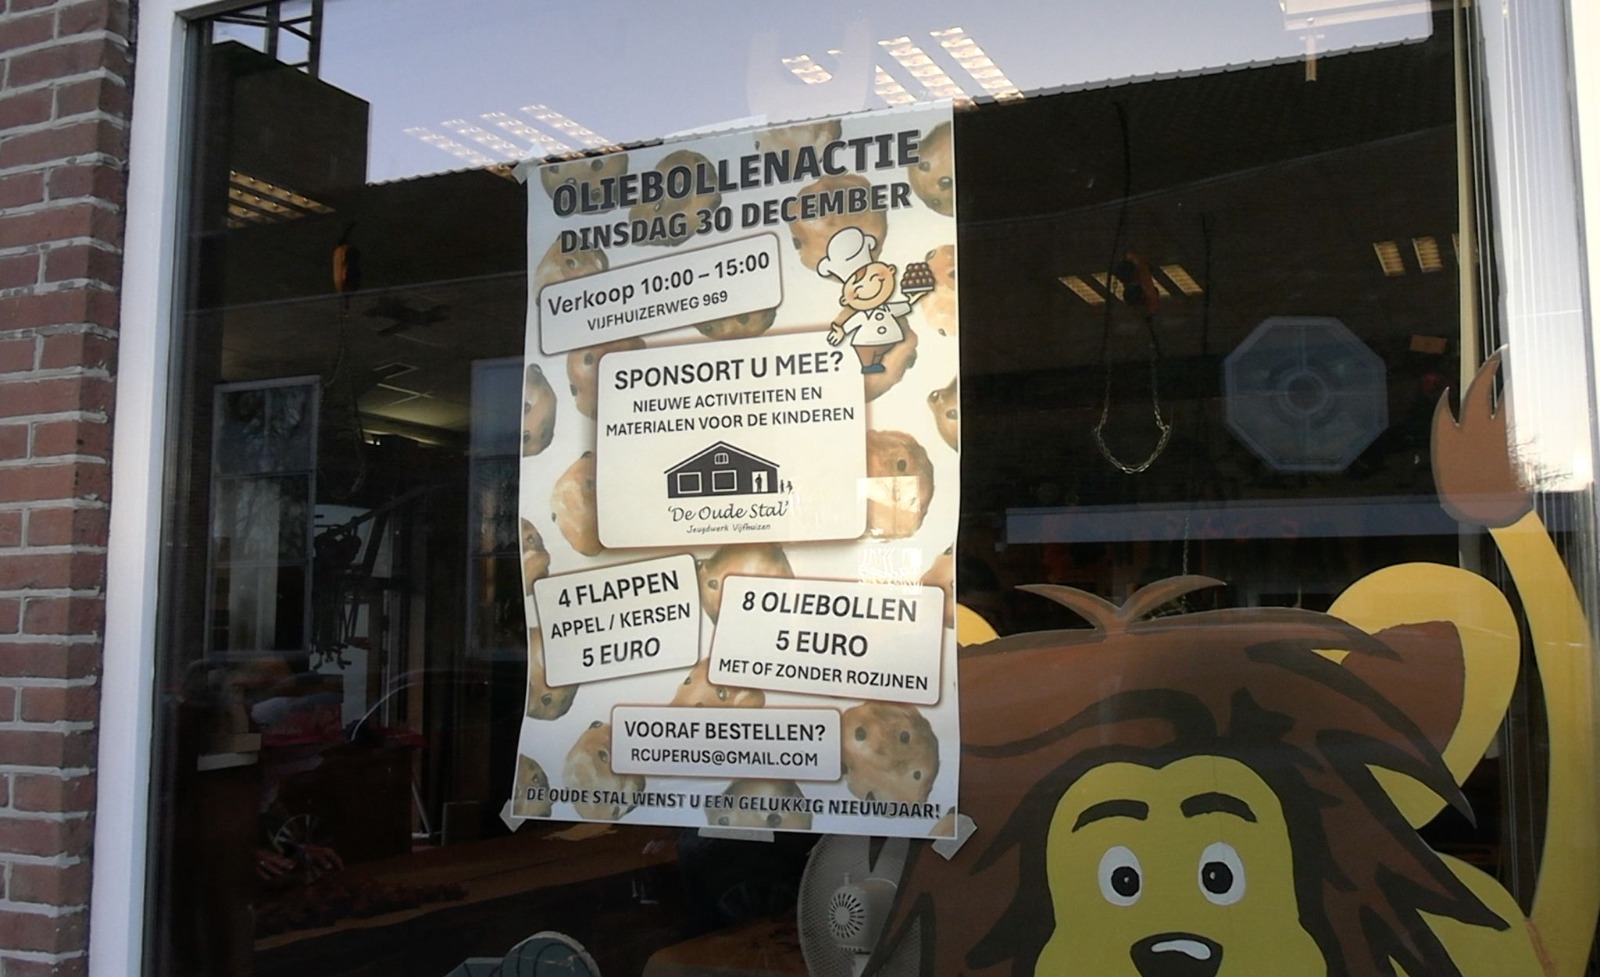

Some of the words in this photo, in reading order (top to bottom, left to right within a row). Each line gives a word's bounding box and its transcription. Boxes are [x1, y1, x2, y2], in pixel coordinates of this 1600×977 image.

[552, 129, 921, 217] OLIEBOLLENACTIE
[560, 213, 688, 255] DINSDAG
[696, 202, 731, 236] 30
[740, 182, 912, 228] DECEMBER
[548, 282, 634, 316] Verkoop
[641, 269, 694, 296] 10:00
[714, 251, 770, 279] 15:00
[587, 296, 699, 331] VIJFHUIZERWEG
[702, 291, 728, 307] 969
[614, 359, 745, 390] SPONSORT
[750, 358, 768, 378] U
[776, 351, 844, 375] MEE?
[633, 396, 690, 413] NIEUWE
[694, 389, 796, 409] ACTIVITEITEN
[802, 387, 822, 400] EN
[606, 418, 695, 436] MATERIALEN
[698, 414, 743, 429] VOOR
[748, 412, 768, 426] DE
[772, 407, 854, 424] KINDEREN
[699, 503, 746, 520] Oude
[558, 589, 571, 608] 4
[576, 570, 679, 606] FLAPPEN
[551, 614, 605, 639] APPEL
[608, 613, 615, 631] /
[620, 603, 690, 627] KERSEN
[742, 591, 755, 612] 8
[761, 592, 917, 622] OLIEBOLLEN
[582, 648, 594, 667] 5
[600, 638, 660, 665] EURO
[776, 631, 790, 651] 5
[796, 632, 868, 657] EURO
[719, 659, 749, 674] MET
[752, 661, 773, 676] OF
[776, 664, 843, 684] ZONDER
[846, 670, 928, 691] ROZIJNEN
[624, 721, 700, 738] VOORAF
[705, 723, 825, 742] BESTELLEN?
[631, 749, 818, 767] RCUPERUS@GMAIL.COM
[527, 788, 545, 801] DE
[549, 789, 589, 803] OUDE
[593, 790, 629, 805] STAL
[632, 793, 686, 808] WENST
[689, 794, 701, 808] U
[704, 794, 734, 810] EEN
[738, 796, 824, 815] GELUKKIG
[828, 800, 940, 818] NIEUWJAAR!
